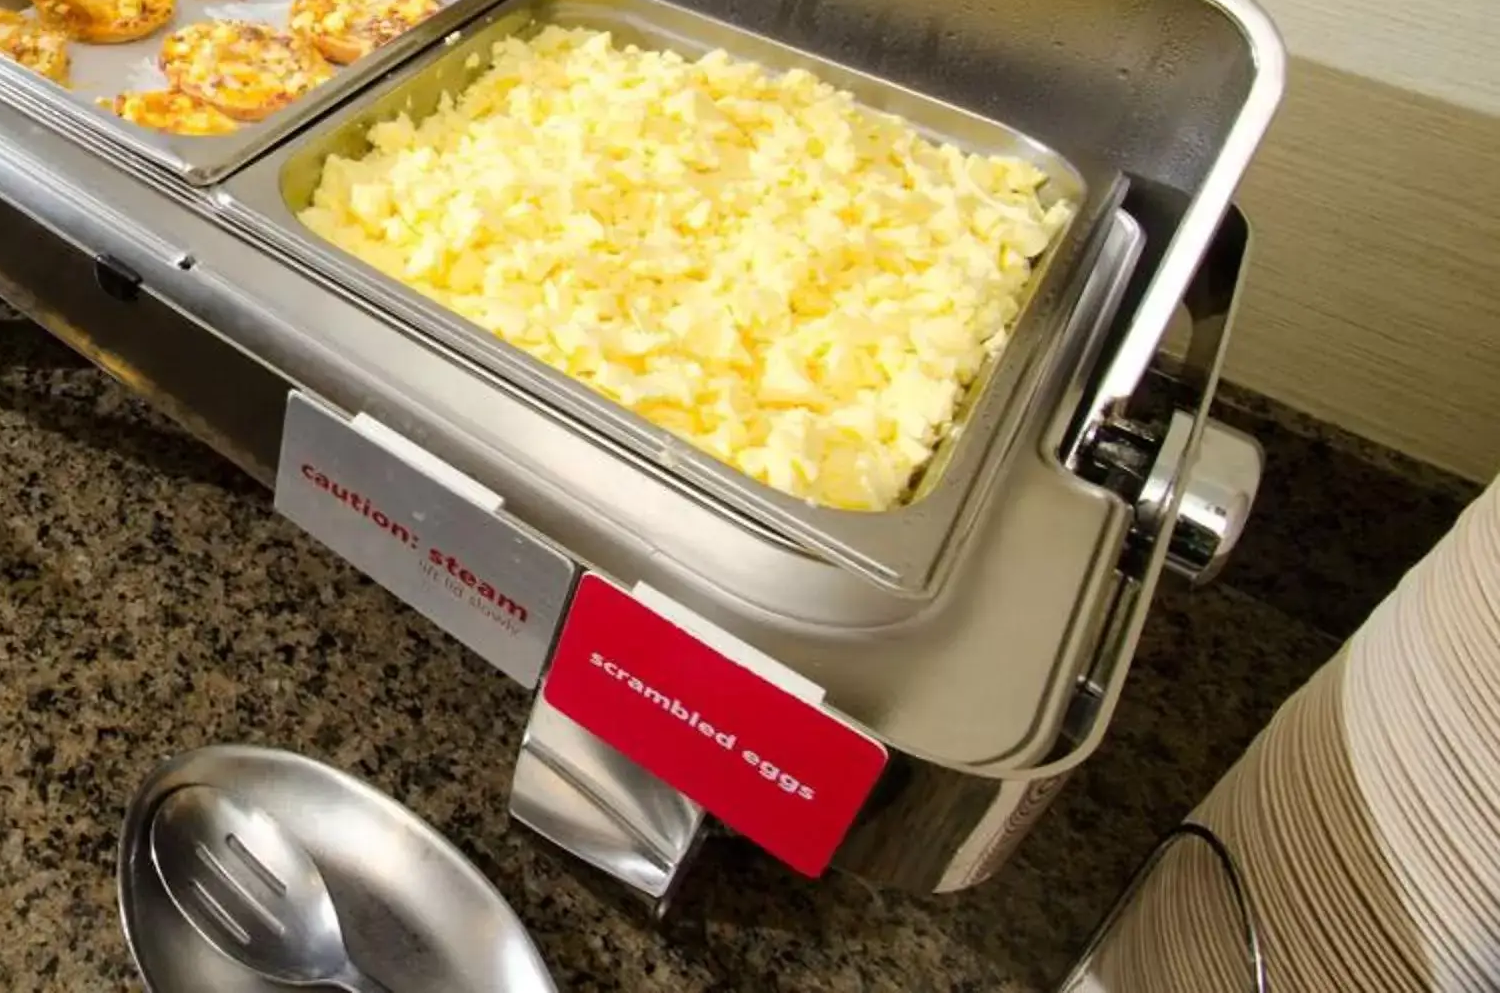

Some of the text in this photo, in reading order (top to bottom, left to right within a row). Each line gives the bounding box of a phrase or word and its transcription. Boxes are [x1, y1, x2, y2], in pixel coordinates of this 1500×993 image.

[301, 462, 528, 623] caution: steam
[589, 651, 816, 801] scrambled eggs
